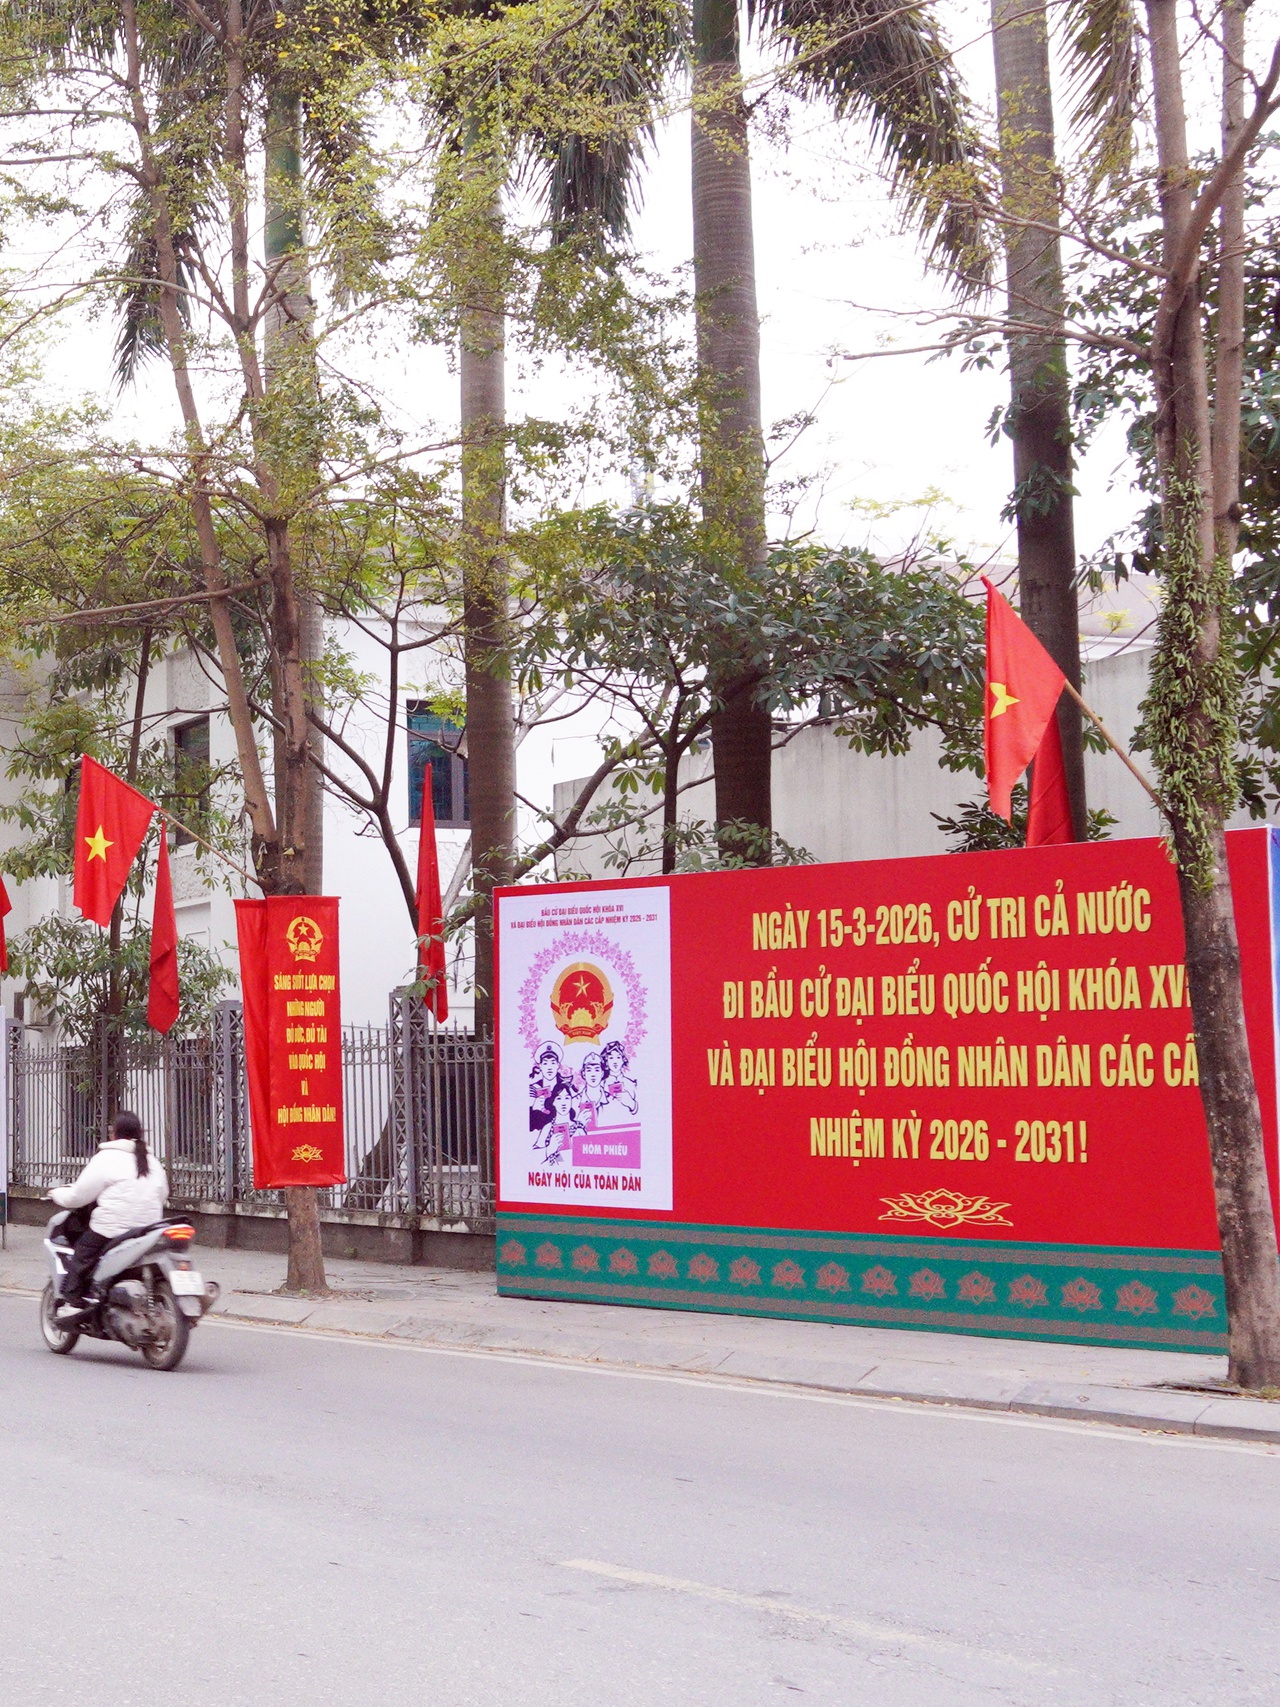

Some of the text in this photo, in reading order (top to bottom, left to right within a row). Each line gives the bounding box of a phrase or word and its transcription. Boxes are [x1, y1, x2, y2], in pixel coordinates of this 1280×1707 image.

[752, 879, 1152, 950] NGÀY 15-3-2026, CỬ TRI CẢ NƯỚC
[274, 971, 291, 990] SÁNG
[722, 981, 744, 1019] ĐI
[751, 966, 794, 1018] BẦU
[800, 964, 832, 1018] CỬ
[836, 976, 874, 1026] ĐẠI
[882, 958, 936, 1016] BIỂU
[943, 956, 1010, 1020] QUỐC
[1017, 960, 1060, 1022] HỘI
[1068, 958, 1142, 1011] KHÓA
[317, 1024, 327, 1043] TÀI
[315, 1051, 326, 1072] HỘI
[707, 1040, 734, 1086] VÀ
[739, 1048, 776, 1096] ĐẠI
[782, 1032, 832, 1087] BIỂU
[839, 1038, 877, 1096] HỘI
[884, 1032, 950, 1088] ĐỒNG
[958, 1036, 1028, 1087] NHÂN
[1036, 1035, 1091, 1087] DÂN
[1100, 1034, 1154, 1088] CÁC
[582, 1141, 628, 1155] HÒM PHIẾU
[810, 1110, 885, 1167] NHIỆM
[892, 1110, 922, 1160] KỲ
[929, 1119, 990, 1160] 2026
[997, 1140, 1008, 1148] -
[528, 1169, 641, 1191] NGÀY HỘI CỦA TOÀN DÂN
